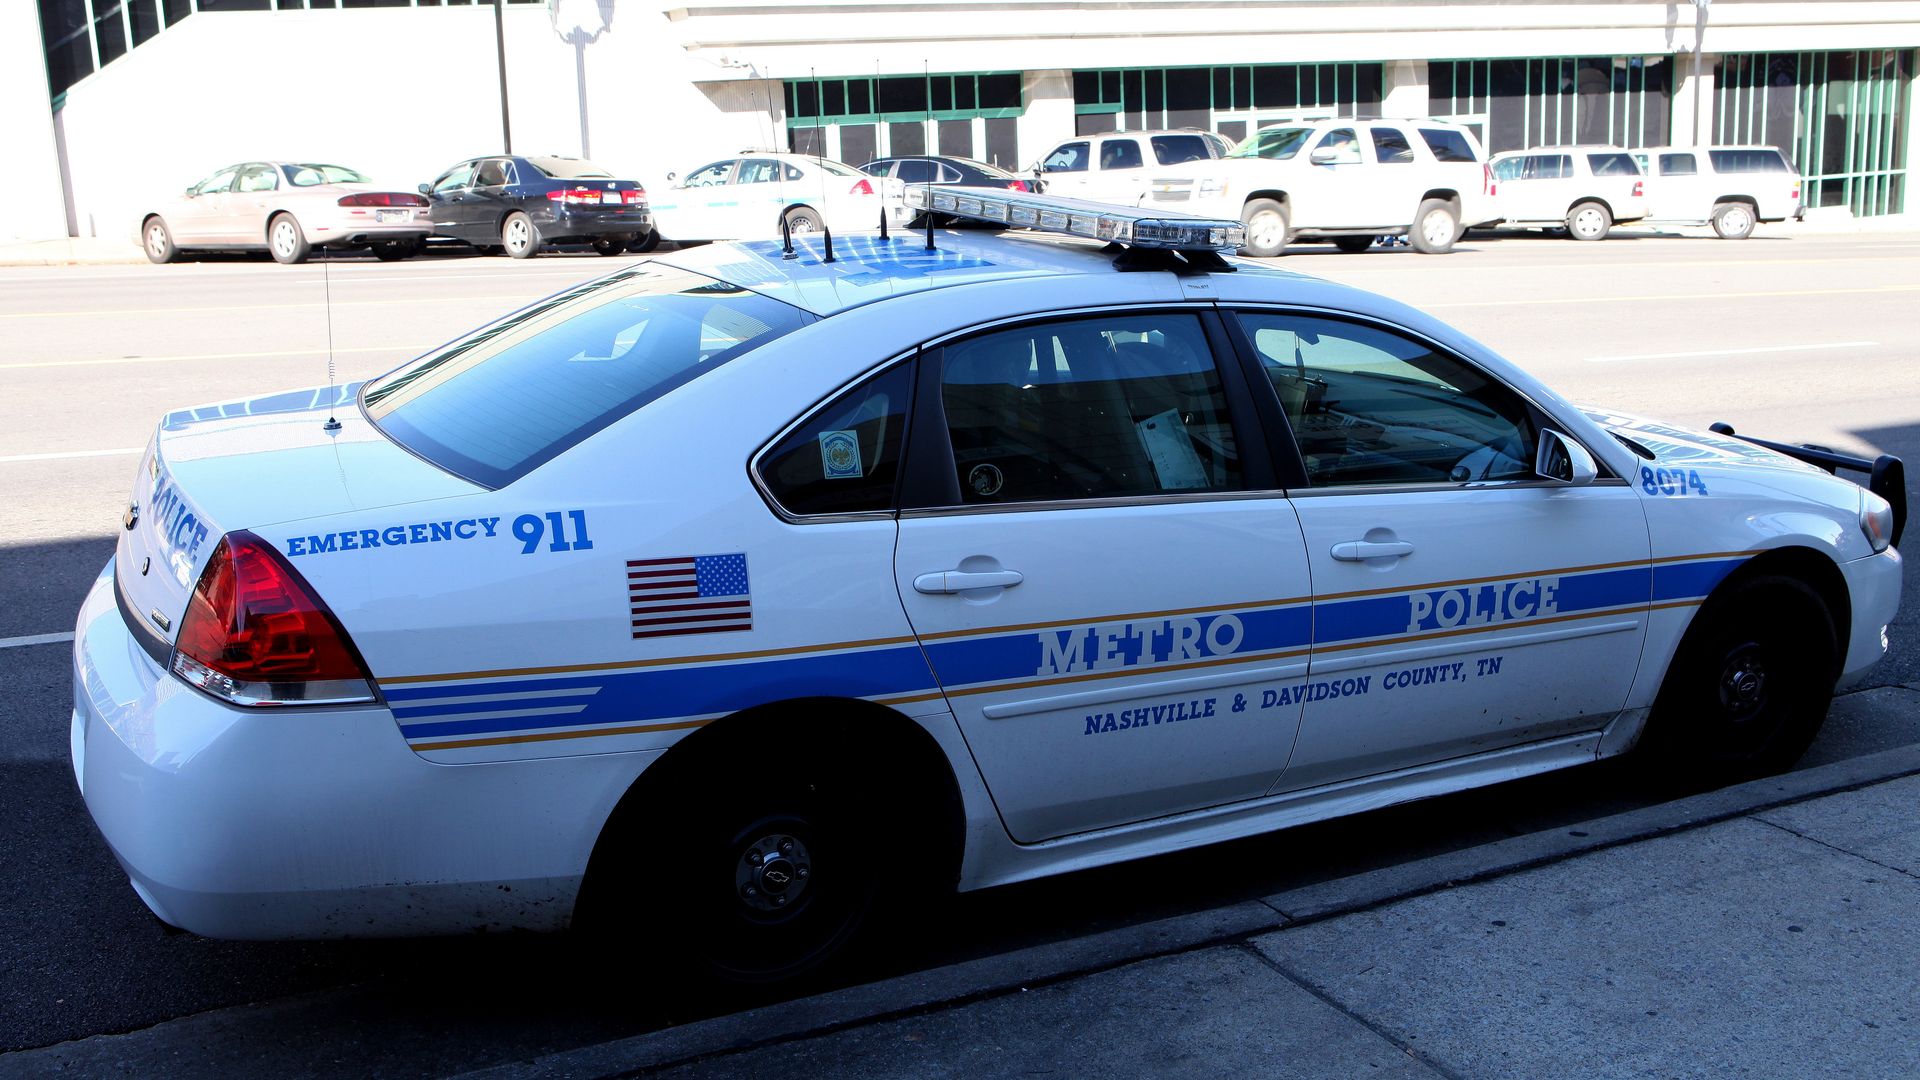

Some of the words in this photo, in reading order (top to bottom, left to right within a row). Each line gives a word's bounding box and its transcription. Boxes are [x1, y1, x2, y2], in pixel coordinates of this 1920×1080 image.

[152, 476, 209, 566] POLICE
[1641, 466, 1708, 496] 8074
[287, 516, 500, 557] EMERGENCY
[512, 509, 594, 554] 911
[1036, 613, 1244, 677] METRO
[1406, 576, 1560, 633] POLICE
[1084, 698, 1217, 736] NASHVILLE
[1231, 692, 1248, 714] &
[1260, 676, 1371, 709] DAVIDSON
[1383, 661, 1468, 691] COUNTY,
[1477, 656, 1504, 677] TN
